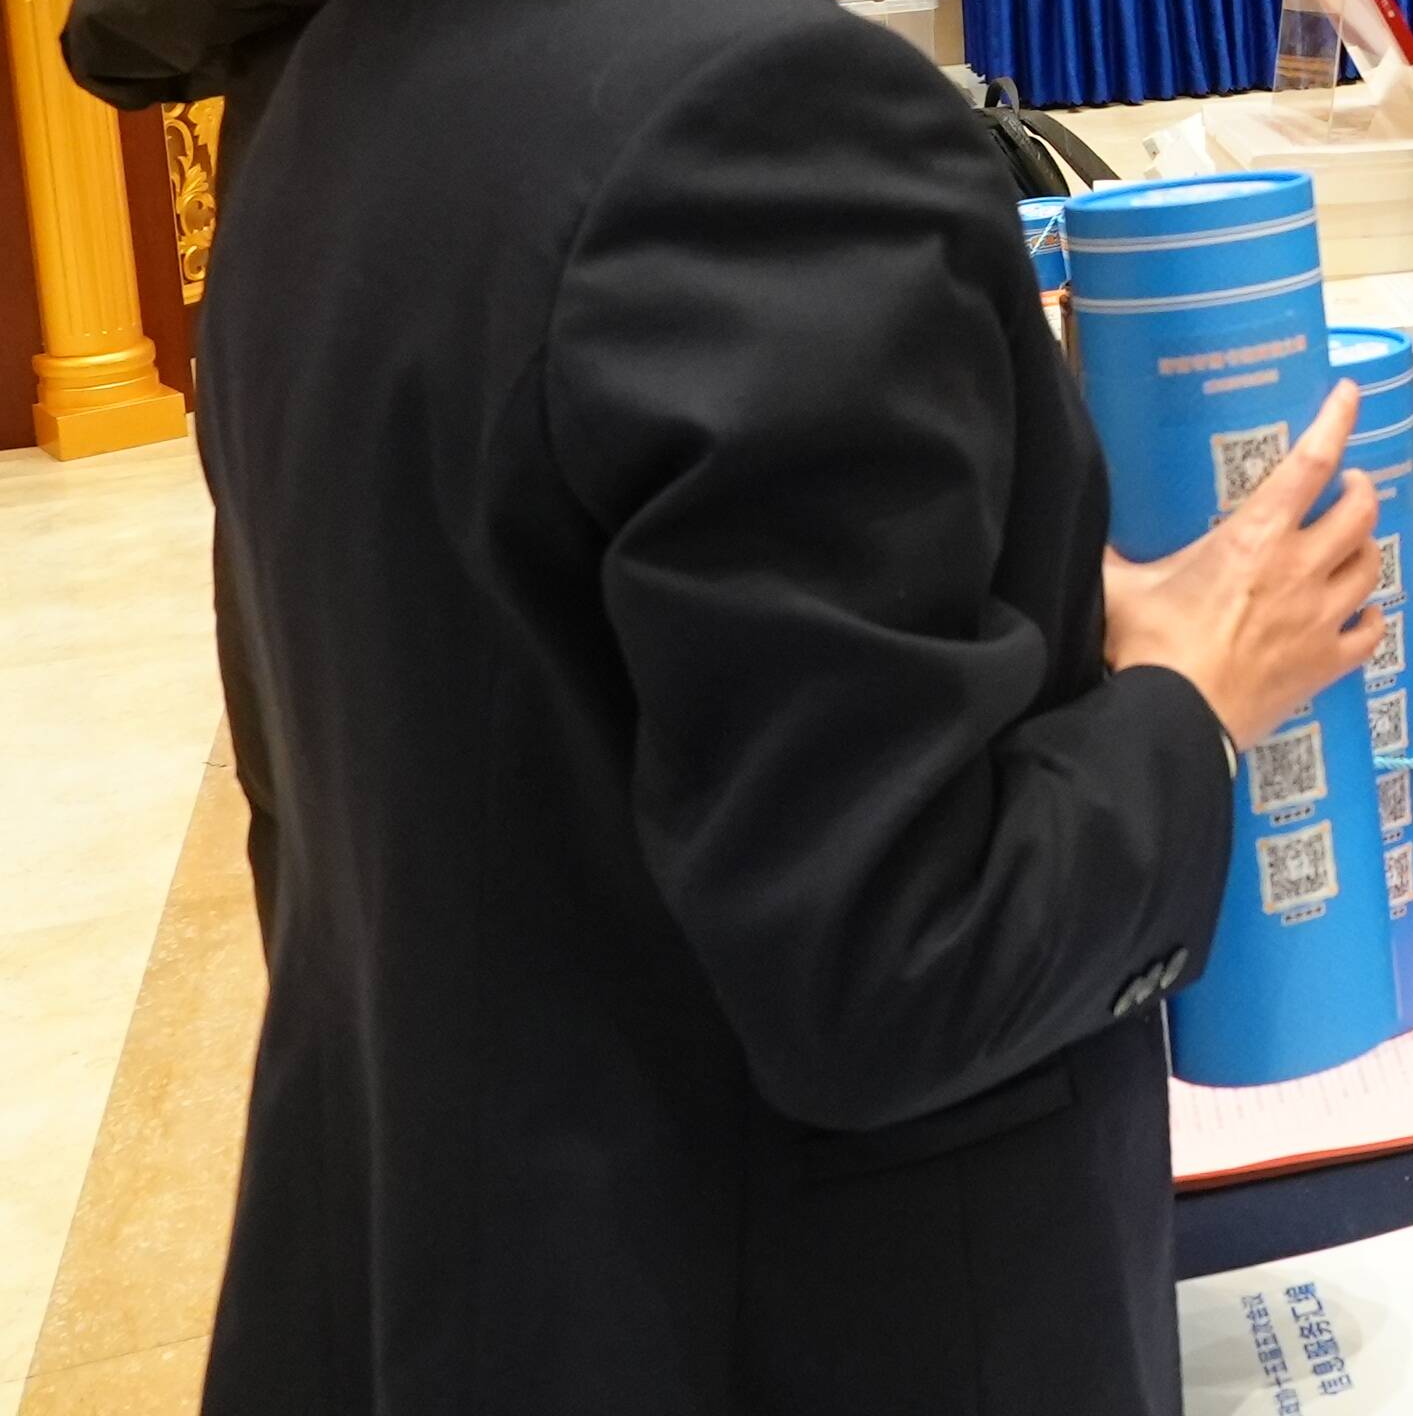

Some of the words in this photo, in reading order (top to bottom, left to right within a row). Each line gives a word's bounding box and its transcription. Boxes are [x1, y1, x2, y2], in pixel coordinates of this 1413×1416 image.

[1285, 1282, 1354, 1395] 信息服务汇编
